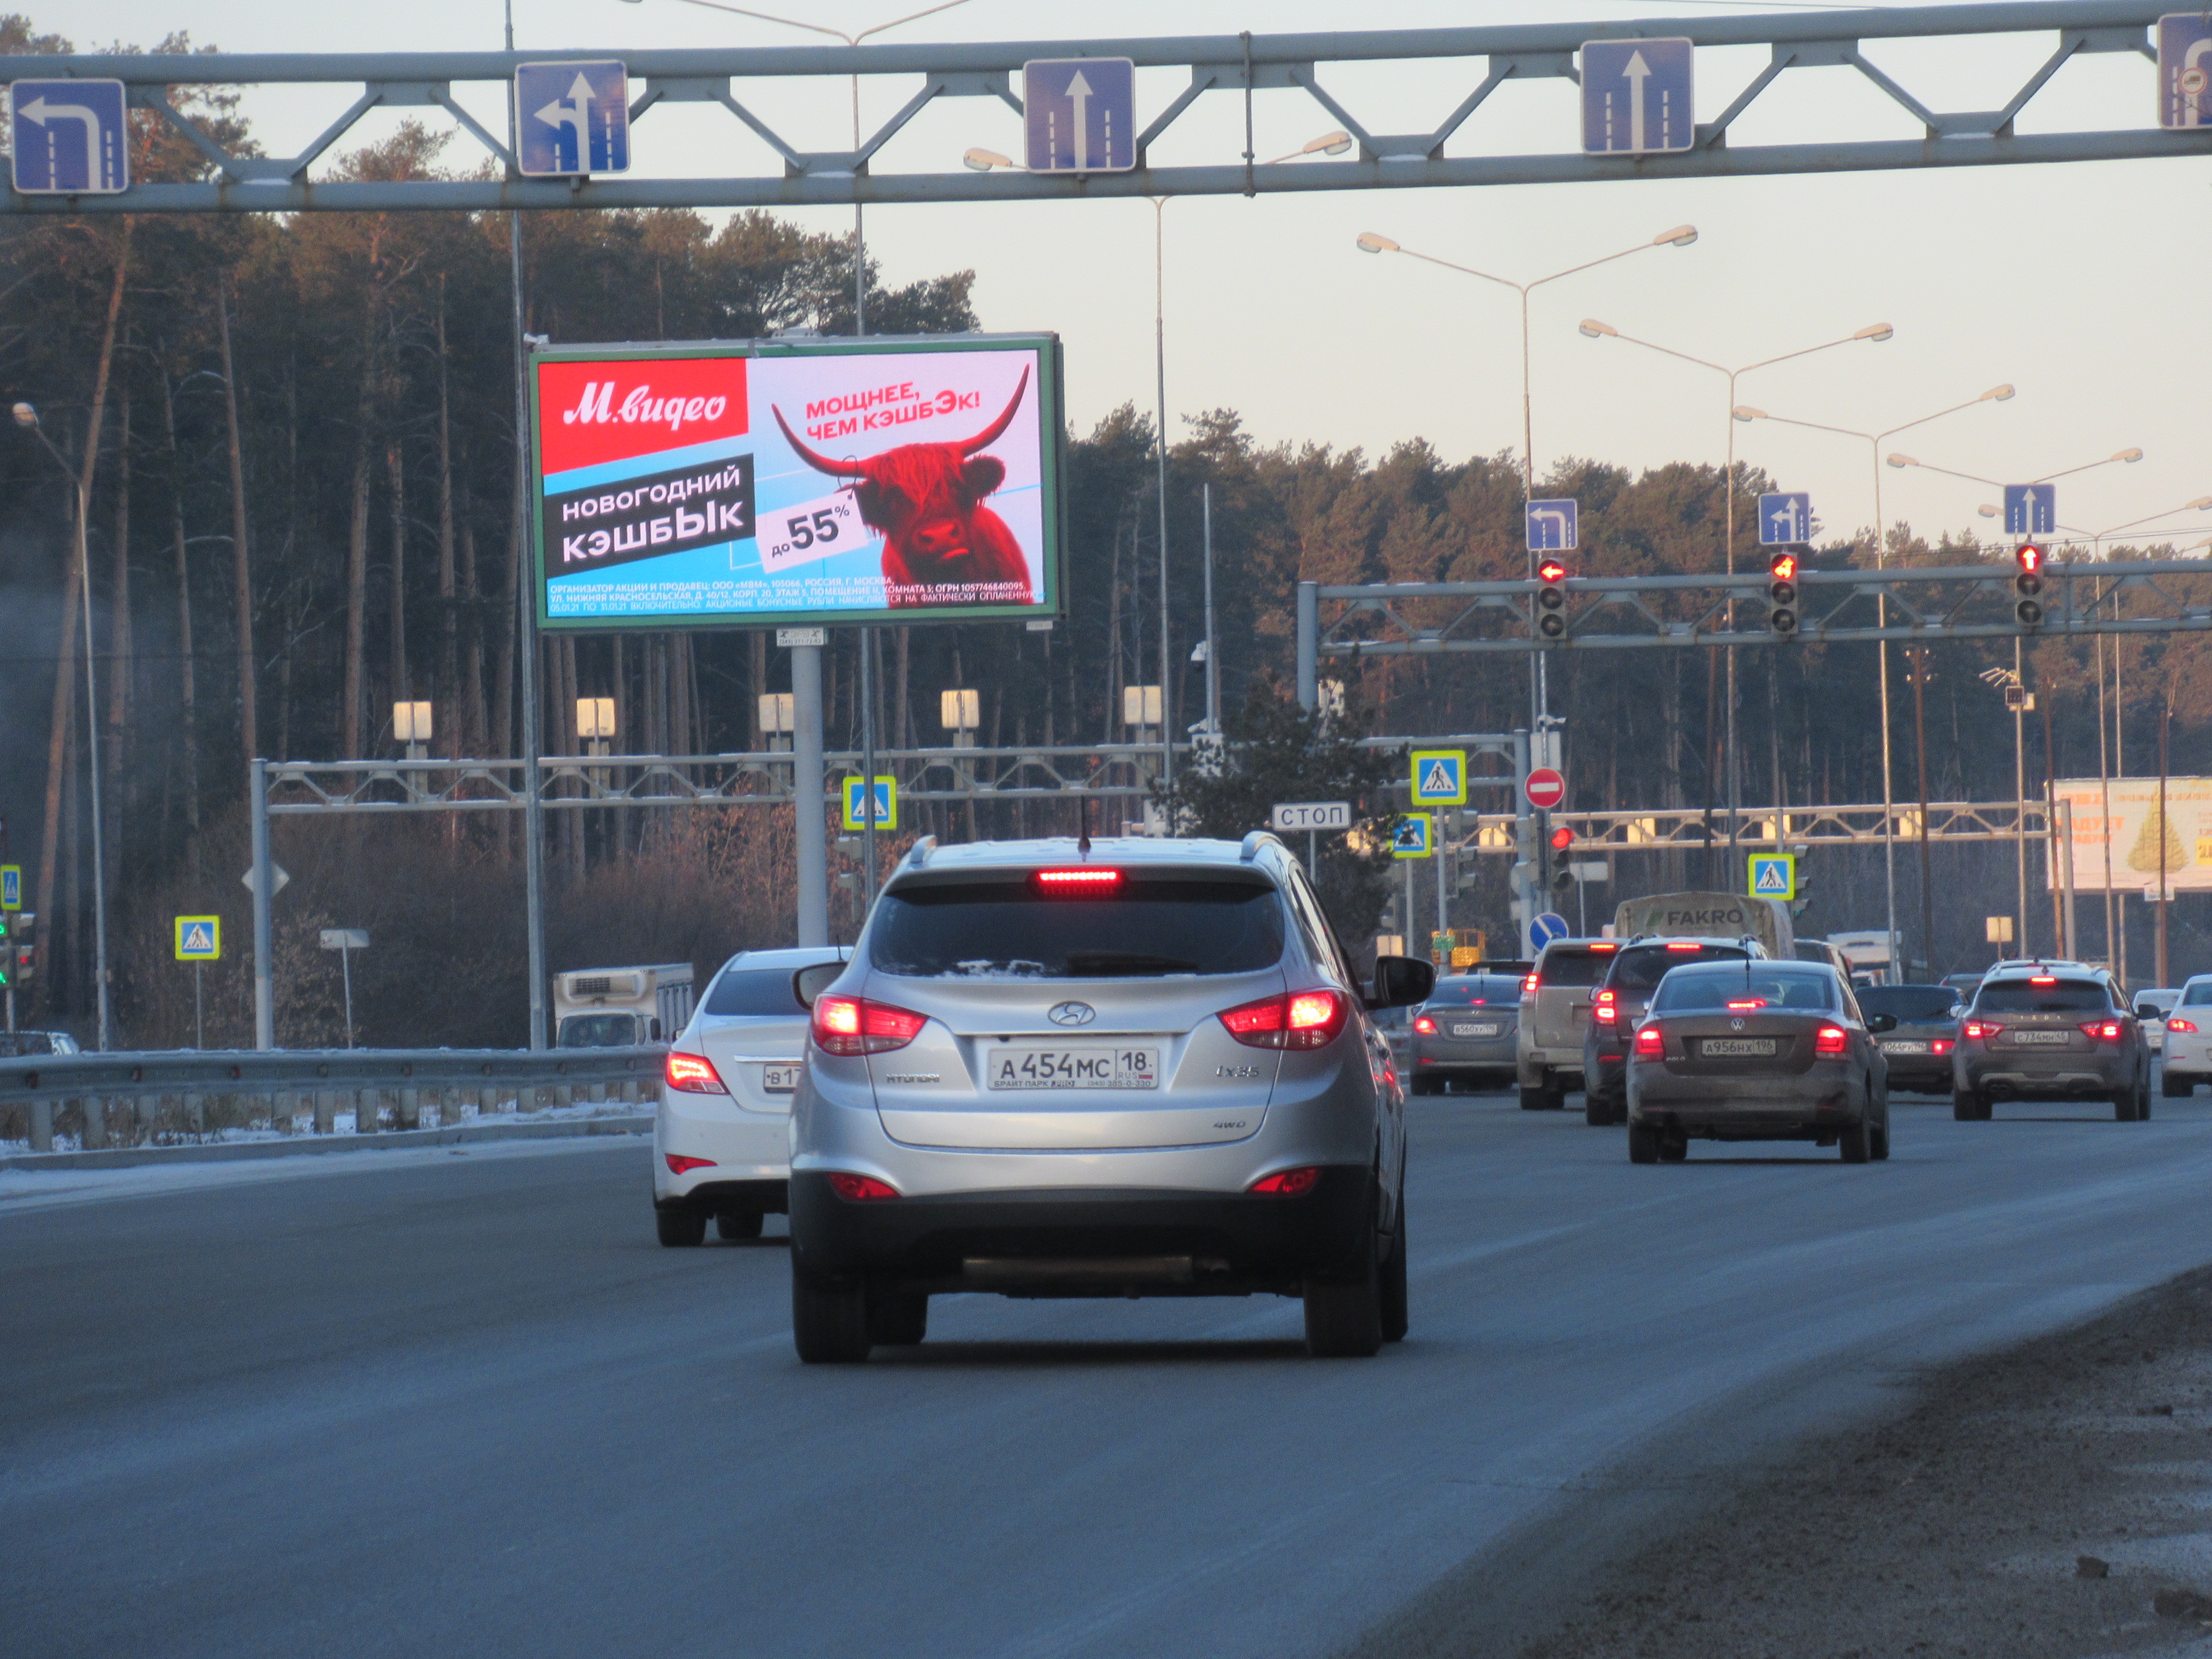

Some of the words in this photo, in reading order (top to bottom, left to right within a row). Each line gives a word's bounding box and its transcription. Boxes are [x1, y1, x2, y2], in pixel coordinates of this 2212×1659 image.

[563, 381, 726, 431] М.видео
[806, 381, 920, 419] МОЩНЕЕ,
[807, 417, 857, 440] ЧЕМ
[863, 390, 980, 431] КЭШБЭК!
[563, 464, 740, 521] НОВОГОДНИЙ
[563, 500, 744, 562] КЭШБЫК
[550, 584, 613, 594] ОРГАНИЗАТОР
[615, 583, 648, 593] АКЦИИ
[660, 582, 710, 592] ПРОДАВЕЦ:
[854, 577, 894, 586] МОСКВА,
[551, 594, 565, 602] УЛ.
[566, 593, 606, 602] НИЖНЯЯ
[609, 591, 693, 602] КРАСНОСЕЛЬСКАЯ,
[695, 591, 704, 601] Д.
[706, 591, 731, 599] 40/12,
[811, 586, 870, 596] ПОМЕЩЕНИЕ
[885, 585, 925, 594] КОМНАТА
[936, 583, 959, 592] ОГРН
[758, 597, 802, 606] БОНУСНЫЕ
[808, 597, 834, 605] РУБЛИ
[839, 594, 901, 604] НАЧИСЛЯЮТСЯ
[905, 594, 917, 603] НА
[921, 592, 975, 602] ФАКТИЧЕСКИ
[1281, 808, 1342, 825] СТОП
[1667, 910, 1743, 925] FAKRO
[1706, 1042, 1752, 1053] А956НХ
[1755, 1041, 1773, 1050] 196
[1000, 1053, 1110, 1079] А454МС
[1121, 1052, 1146, 1071] 18
[886, 1073, 940, 1084] HYUNDAI
